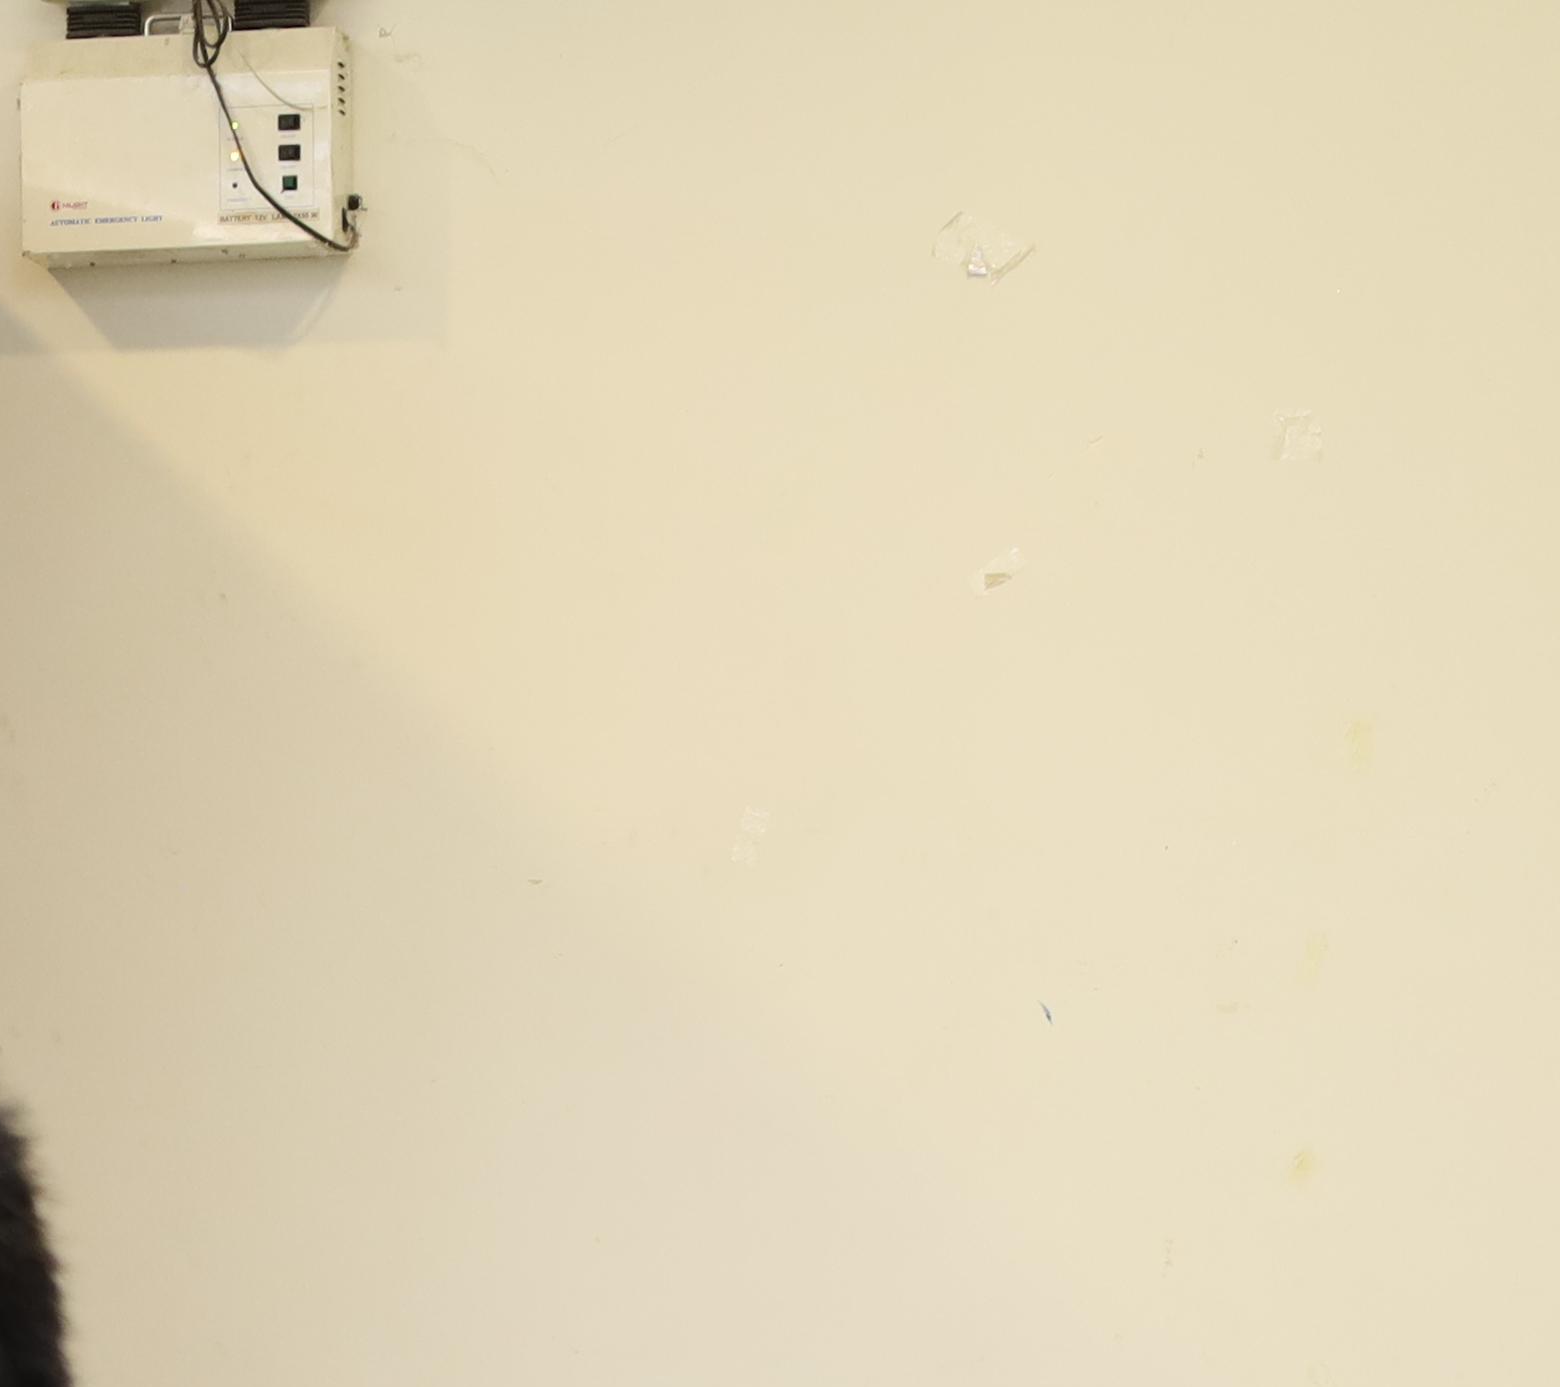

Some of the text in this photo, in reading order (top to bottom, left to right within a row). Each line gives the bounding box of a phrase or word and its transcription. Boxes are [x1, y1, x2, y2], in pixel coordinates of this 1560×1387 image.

[50, 214, 163, 227] AUTOMATIC EMERGENCY LIGHT
[219, 214, 252, 222] BATTERY
